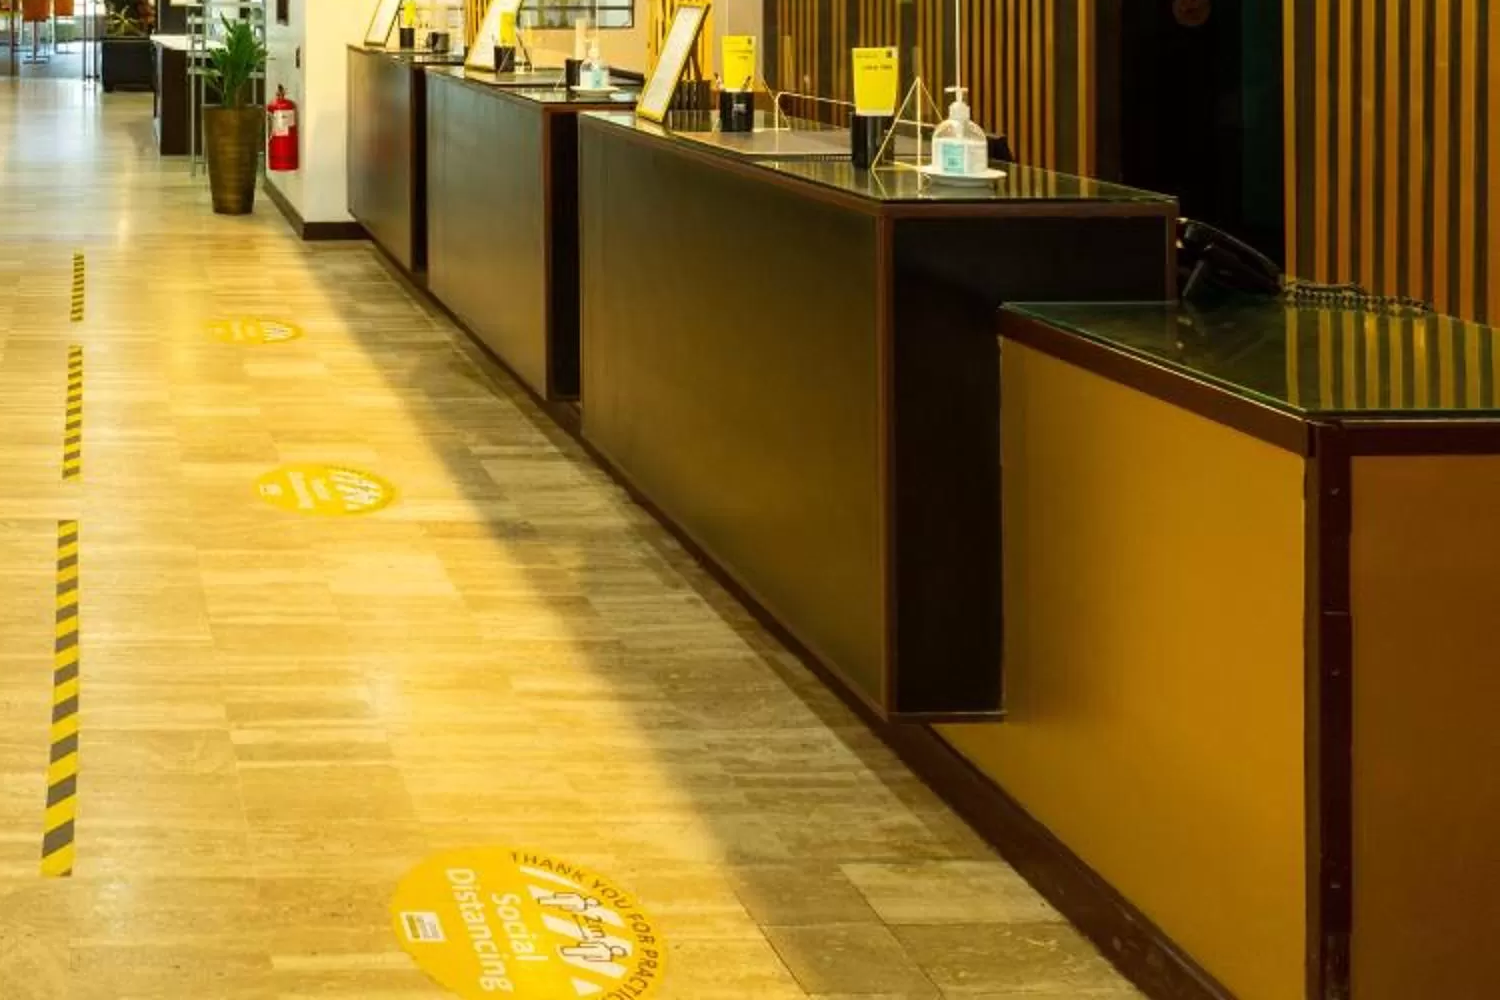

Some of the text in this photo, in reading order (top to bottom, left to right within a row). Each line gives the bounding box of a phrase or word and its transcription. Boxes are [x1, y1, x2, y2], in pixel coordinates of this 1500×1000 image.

[445, 867, 515, 993] Distancing
[491, 892, 549, 962] Social
[510, 852, 586, 882] THANK
[591, 879, 633, 910] YOU
[626, 912, 656, 945] FOR
